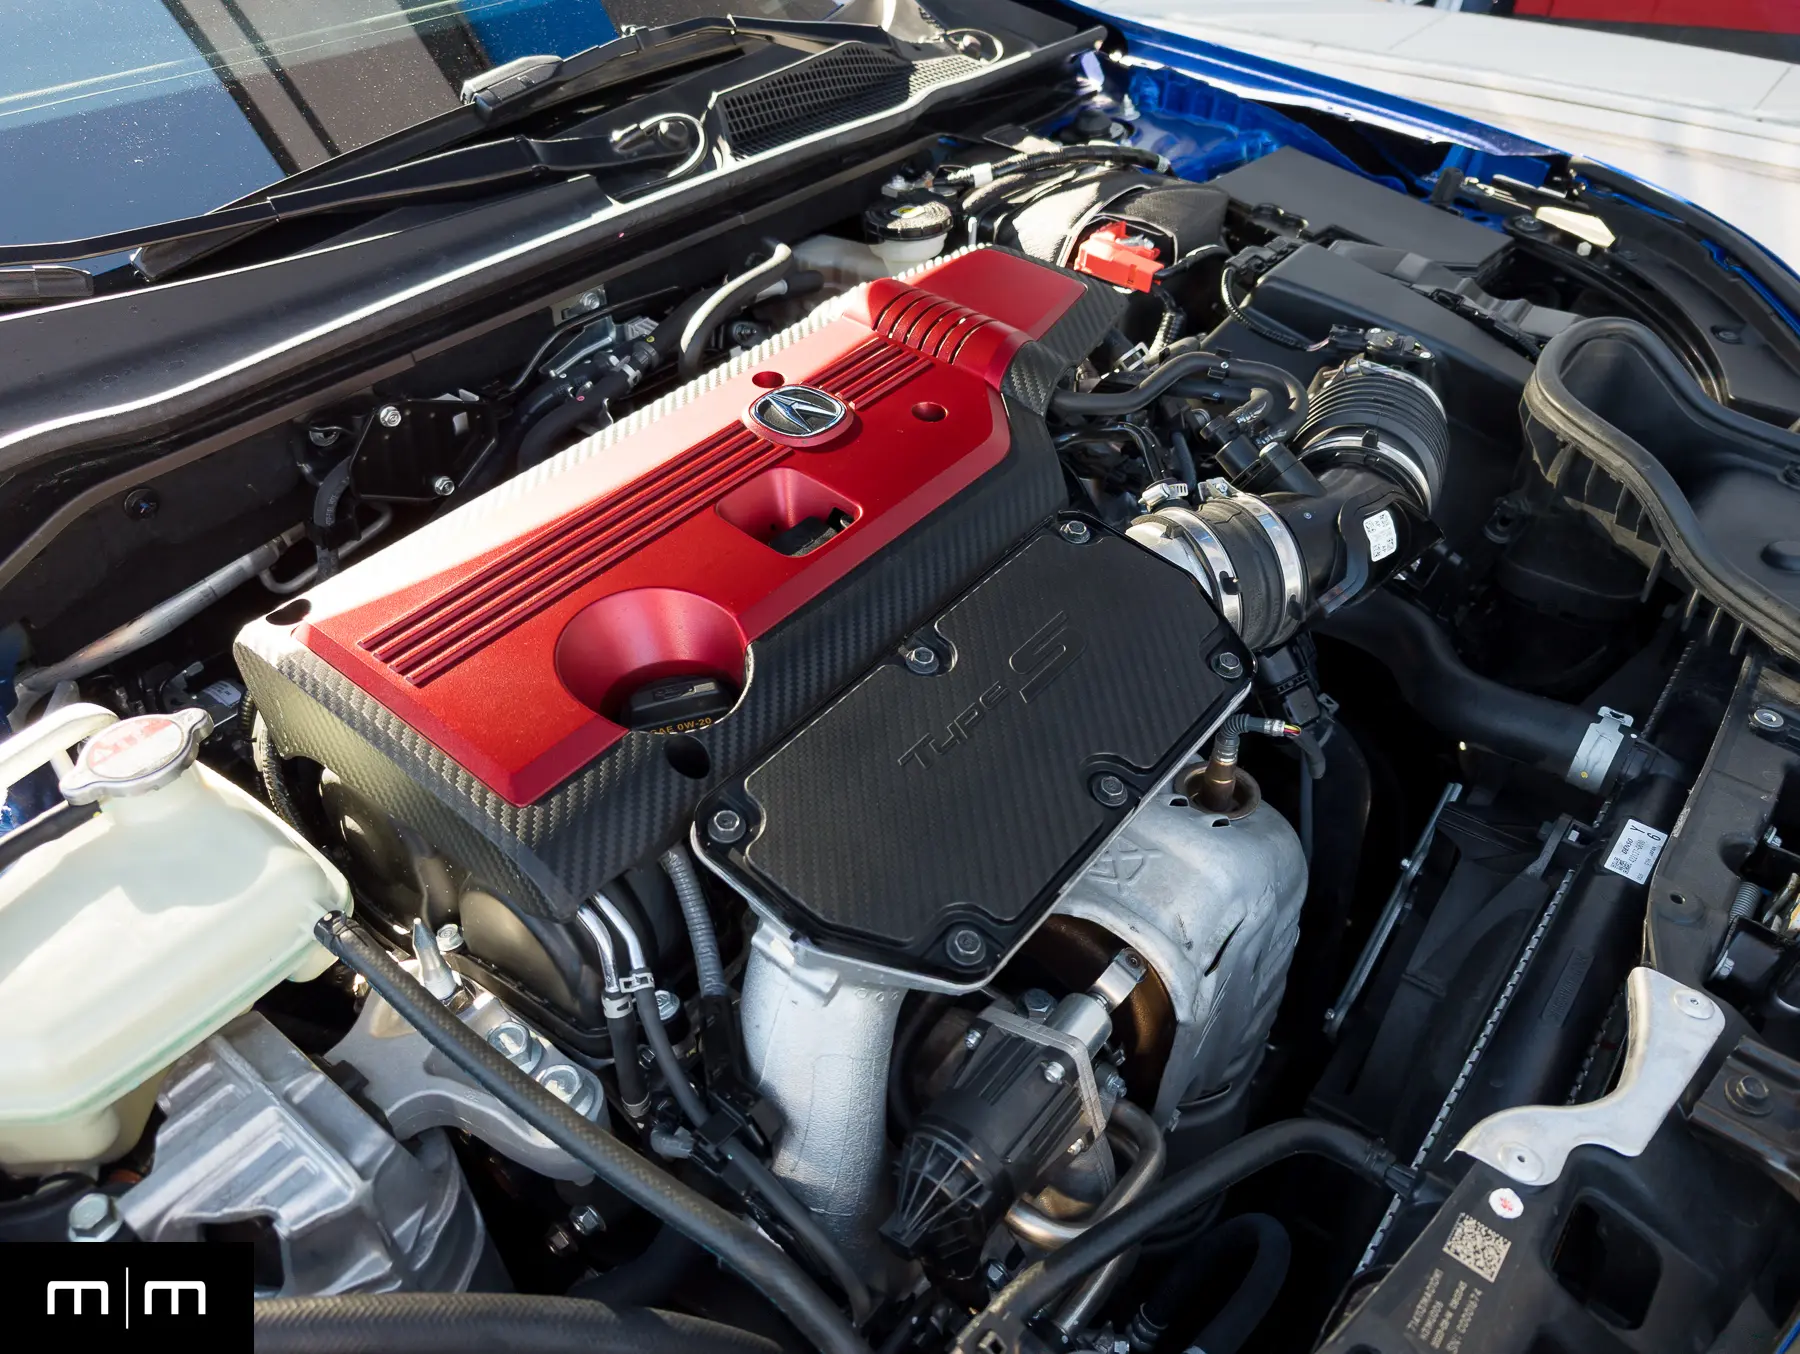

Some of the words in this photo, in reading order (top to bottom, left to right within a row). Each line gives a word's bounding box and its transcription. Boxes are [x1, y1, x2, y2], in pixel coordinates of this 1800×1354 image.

[1008, 610, 1087, 704] S
[677, 717, 712, 731] 0W-20
[1621, 838, 1633, 854] DENSO
